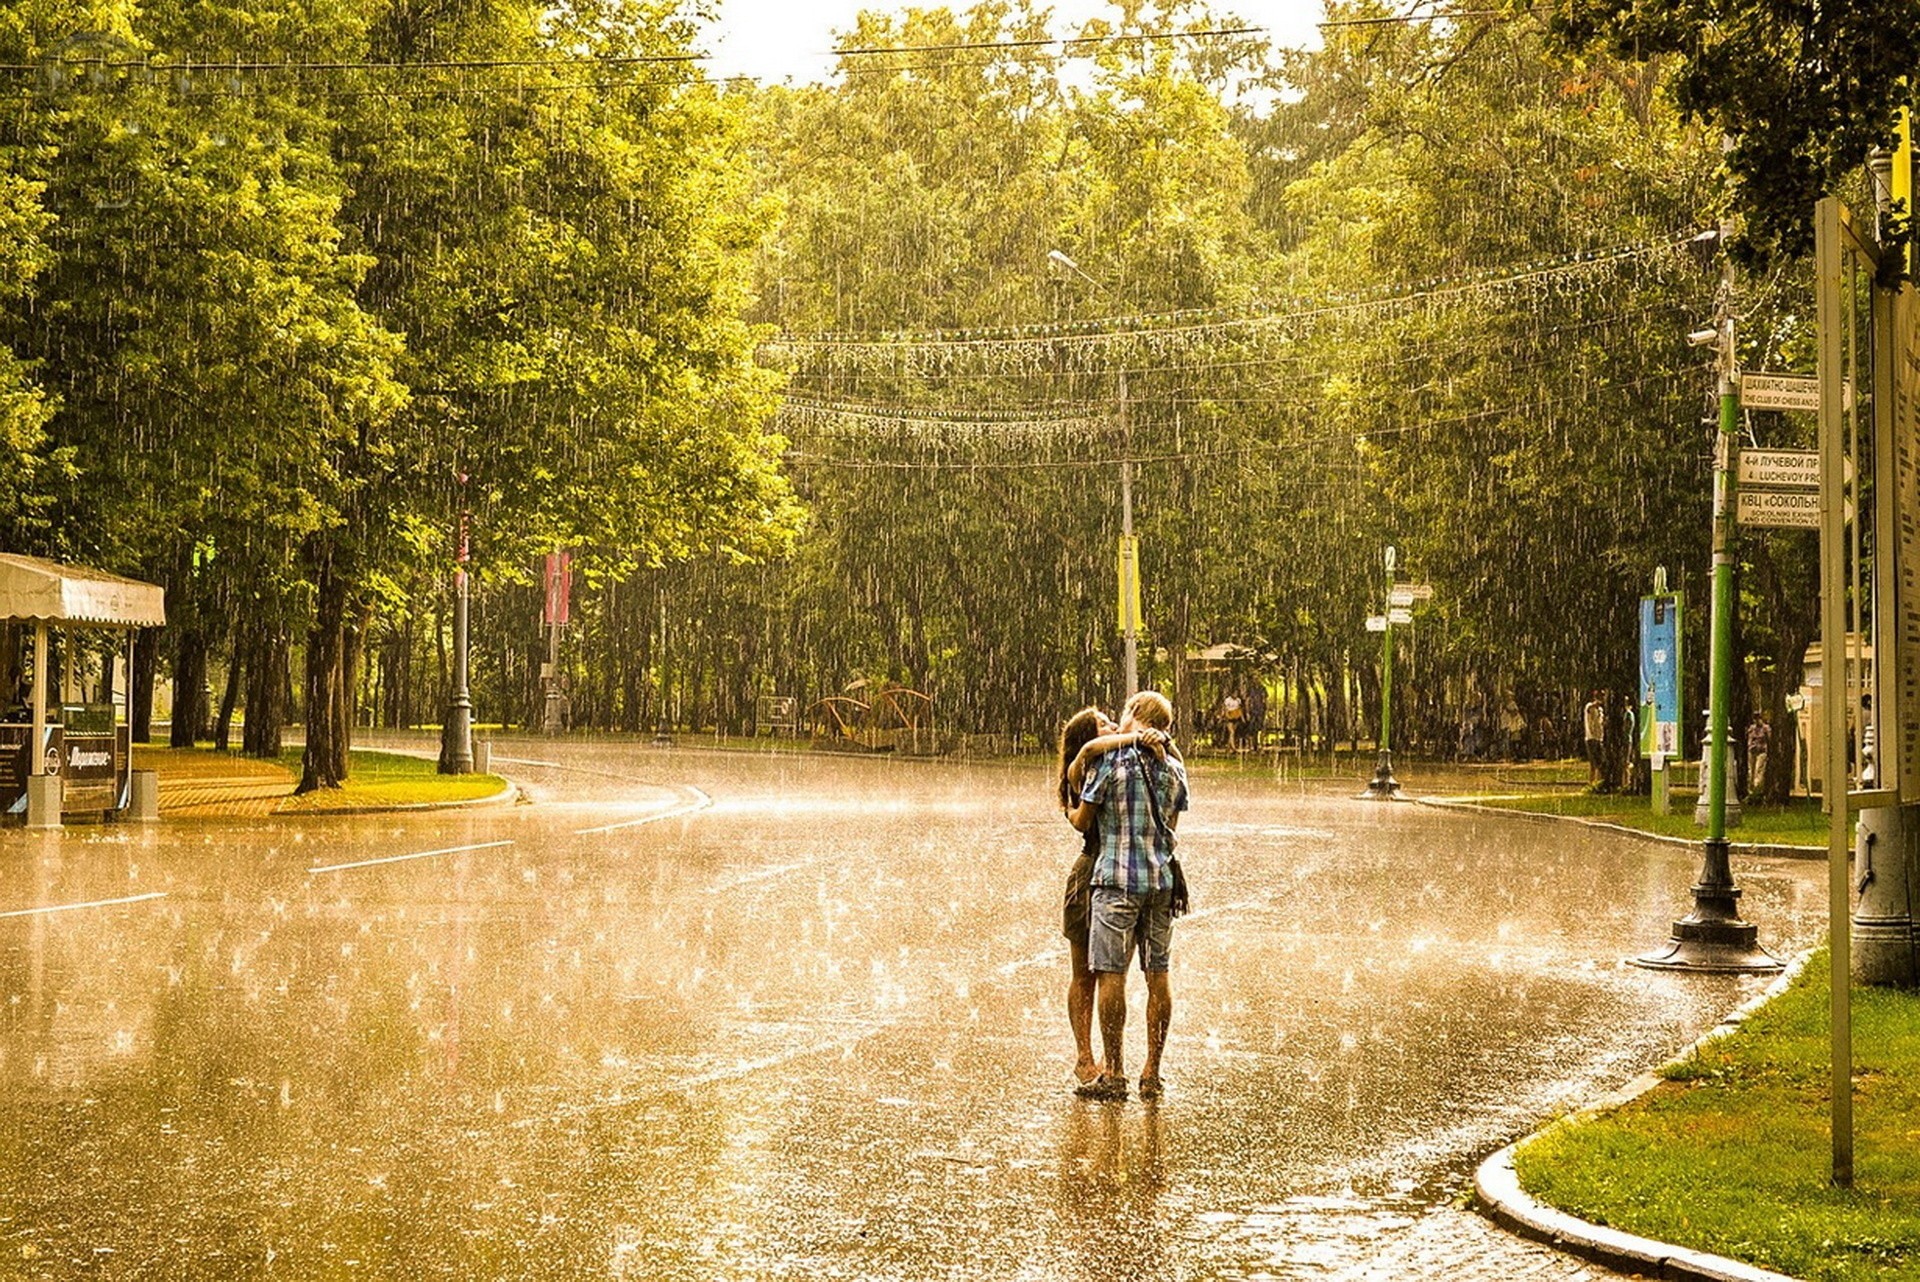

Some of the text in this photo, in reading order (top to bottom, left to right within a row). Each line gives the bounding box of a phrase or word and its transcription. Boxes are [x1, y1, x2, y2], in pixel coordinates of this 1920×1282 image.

[1745, 395, 1756, 403] THE
[1773, 396, 1781, 405] OF
[1782, 397, 1800, 406] CHESS
[1802, 399, 1813, 407] AND
[1760, 456, 1804, 467] ЛУЧЕВОЙ
[1760, 471, 1803, 482] LUCHEVOY
[1742, 495, 1818, 508] КВЦ «СОКОЛЬН
[1761, 516, 1809, 524] CONVENTION
